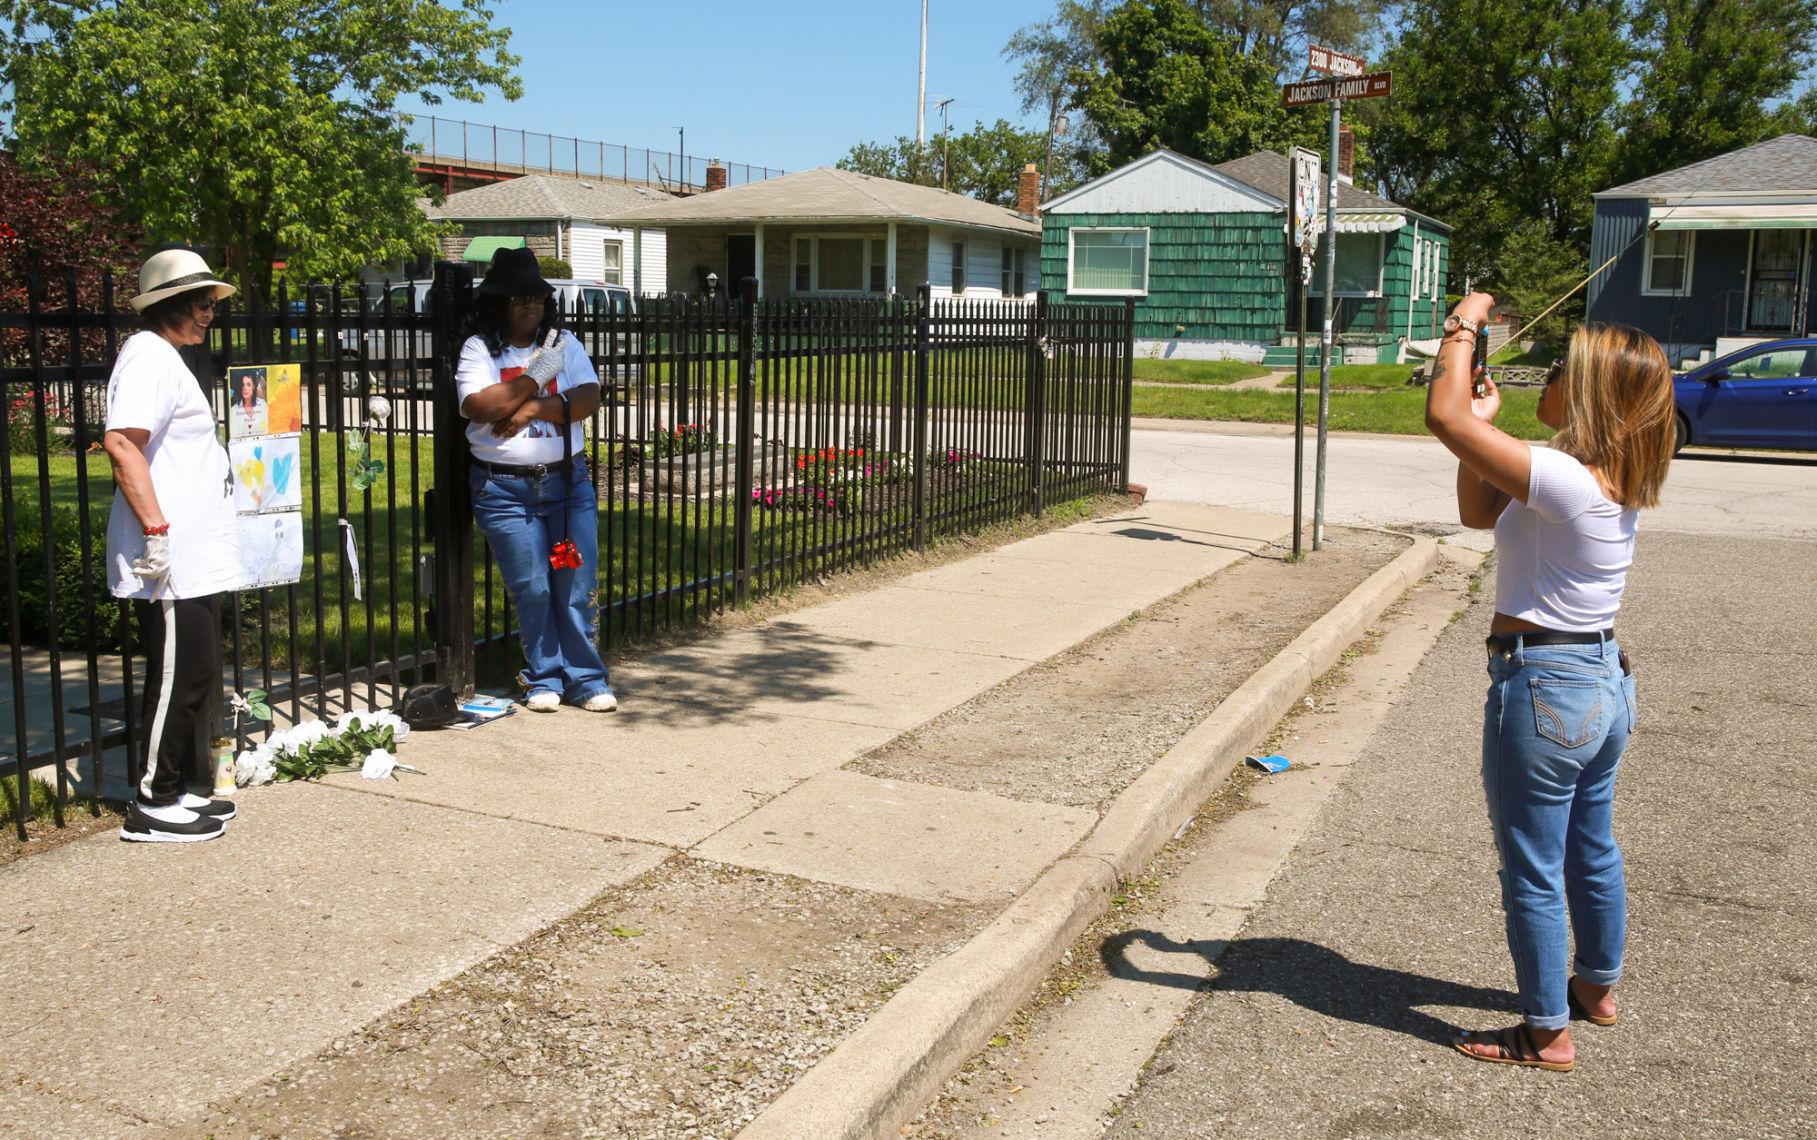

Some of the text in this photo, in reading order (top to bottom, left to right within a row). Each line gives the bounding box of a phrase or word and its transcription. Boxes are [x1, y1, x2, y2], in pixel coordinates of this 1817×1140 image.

[1329, 54, 1357, 76] JACKSON
[1288, 83, 1331, 103] JACKSON
[1335, 80, 1370, 97] FAMILY
